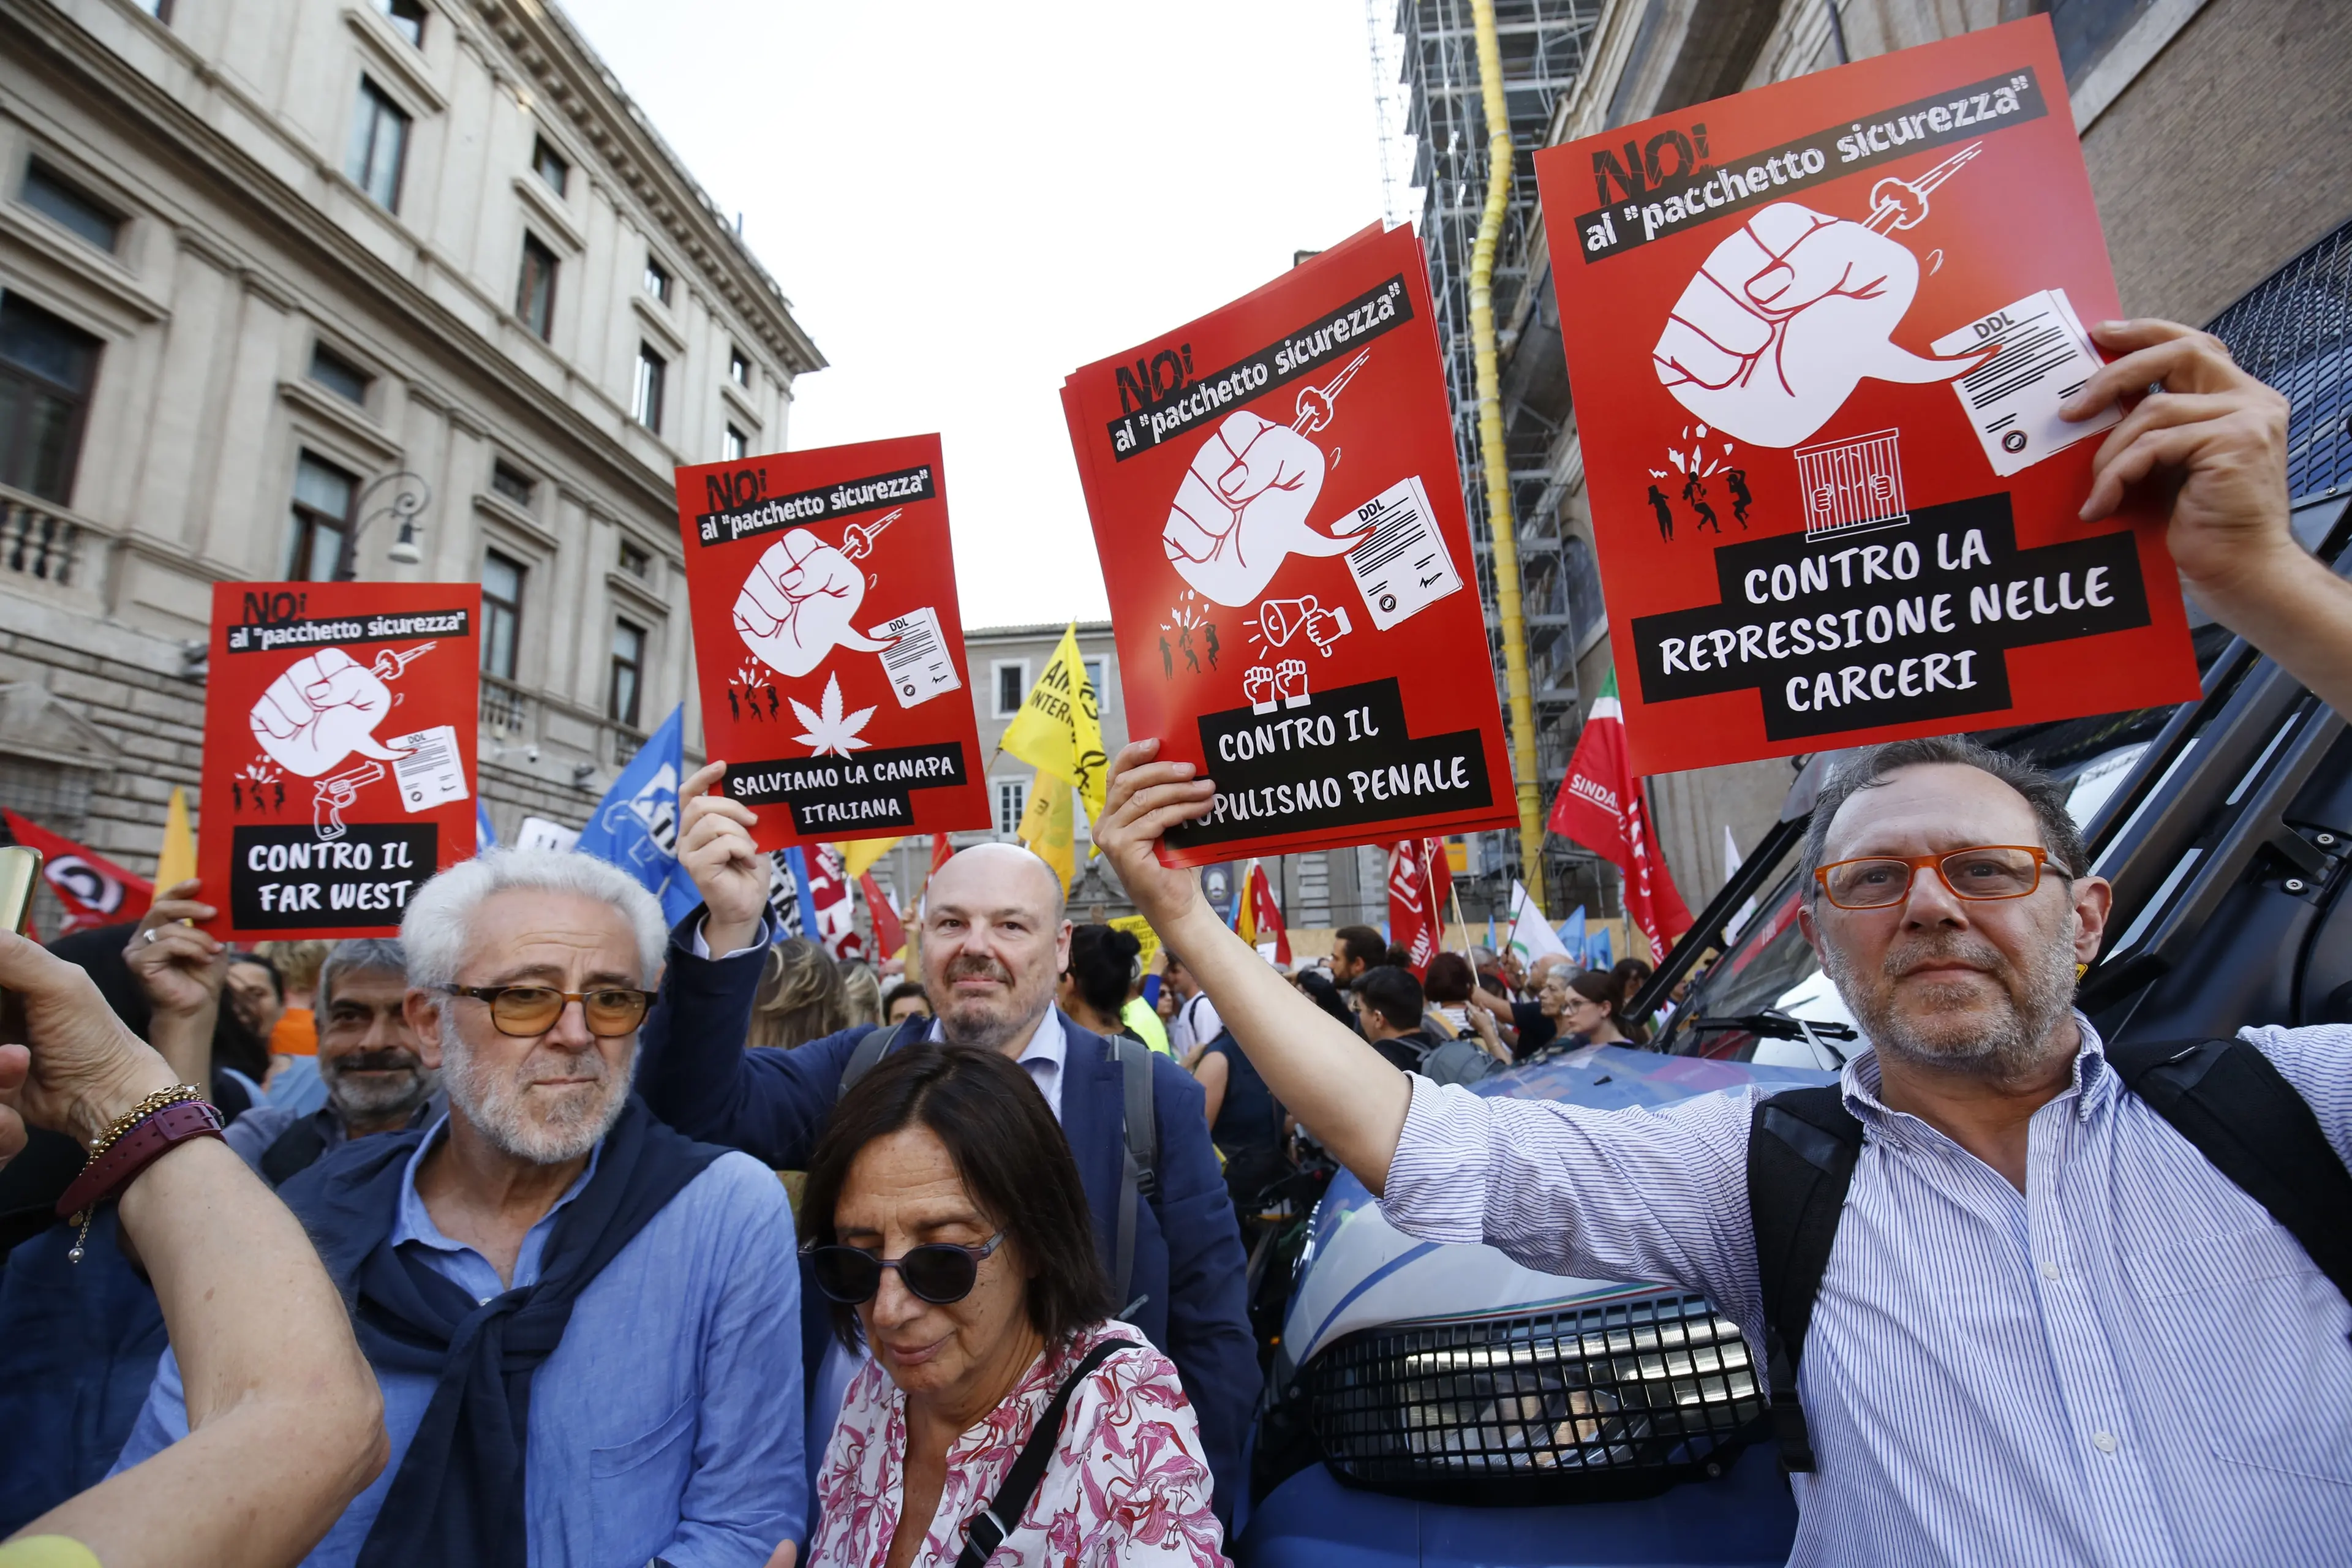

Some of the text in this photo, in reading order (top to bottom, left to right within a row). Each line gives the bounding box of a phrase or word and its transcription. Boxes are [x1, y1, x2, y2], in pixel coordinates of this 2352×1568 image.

[1586, 75, 2029, 252] al "pacchetto sicurezza"
[1973, 311, 2015, 339] DDL
[1116, 282, 1401, 452] al "pacchetto sicurezza"
[701, 469, 927, 540] al "pacchetto sicurezza"
[1357, 499, 1385, 522] DDL
[1744, 529, 1991, 604] CONTRO LA
[230, 612, 466, 650] al "pacchetto sicurezza"
[889, 617, 908, 633] DDL
[1659, 566, 2114, 675] REPRESSIONE NELLE
[1786, 650, 1978, 712] CARCERI
[408, 733, 426, 744] DDL
[1219, 707, 1379, 762] CONTRO IL
[733, 756, 954, 796] SALVIAMO LA CANAPA
[1182, 756, 1470, 829] PULISMO PENALE
[802, 798, 902, 824] ITALIANA
[248, 842, 413, 872] CONTRO IL
[258, 880, 413, 913] FAR WEST
